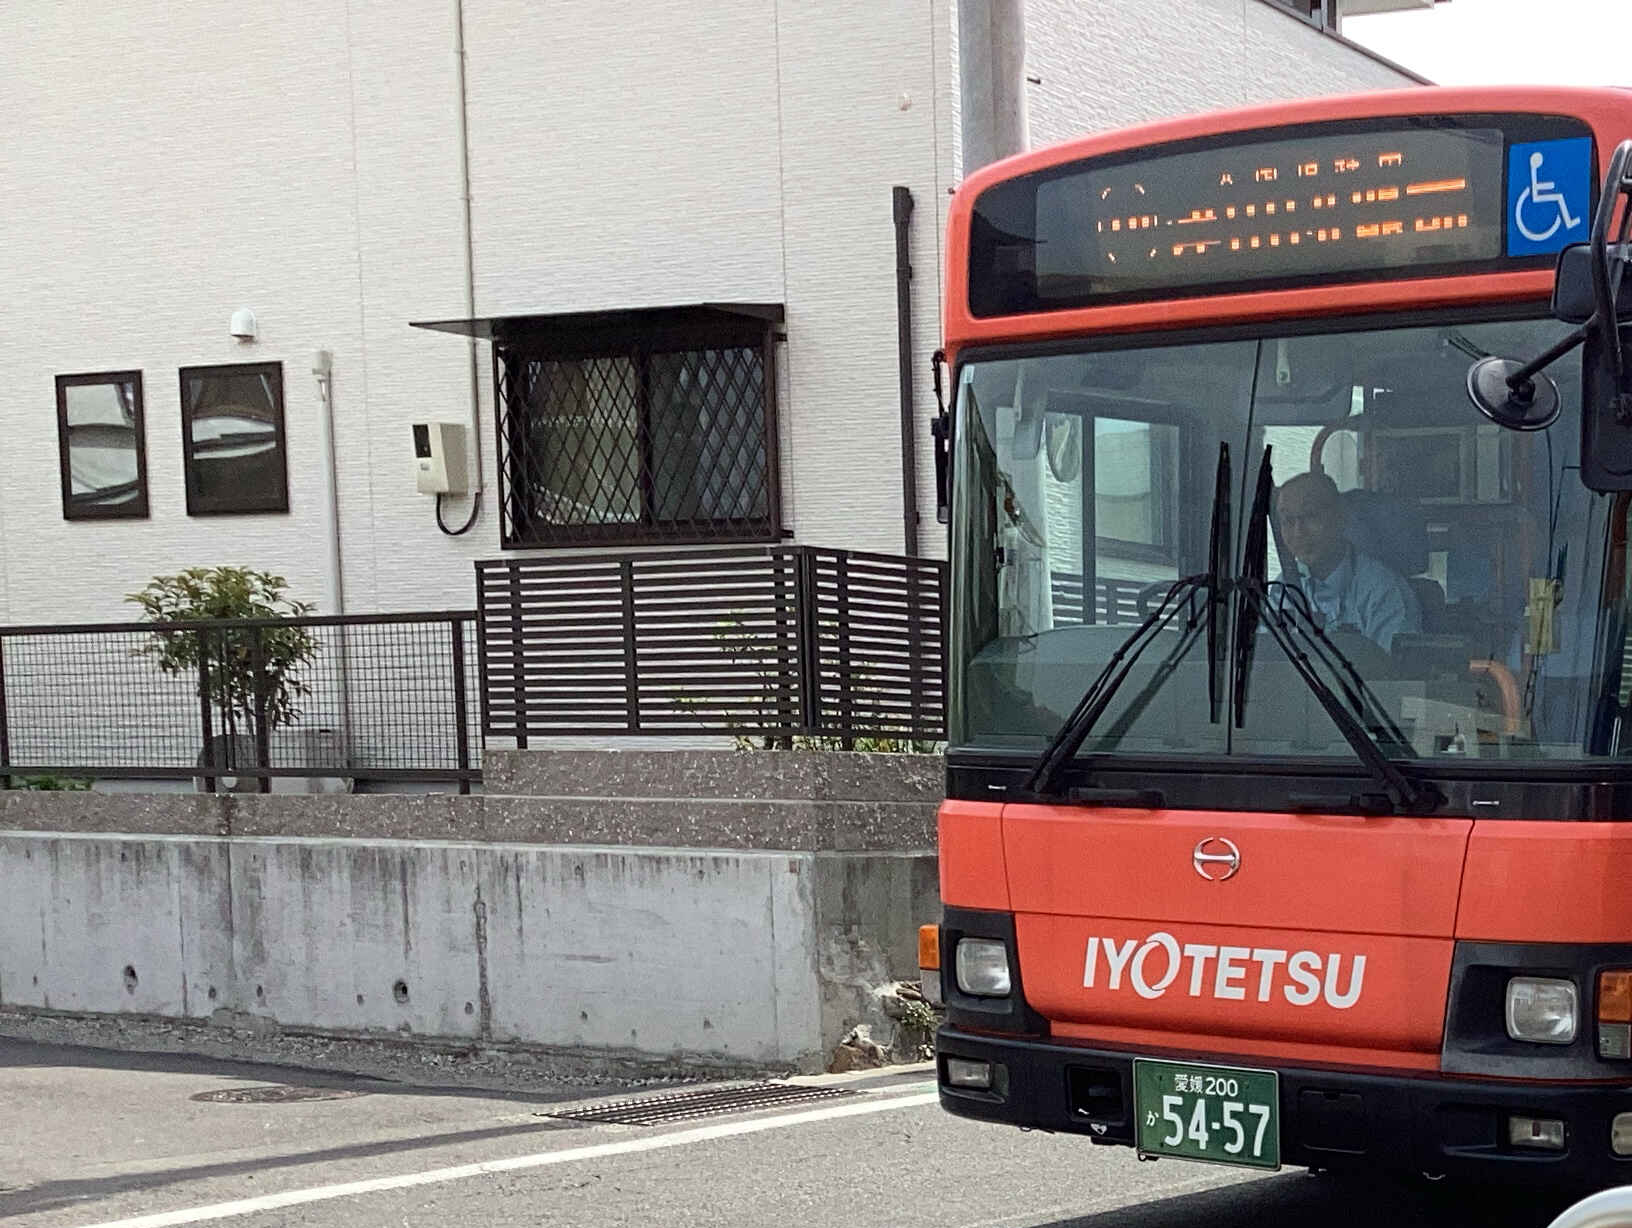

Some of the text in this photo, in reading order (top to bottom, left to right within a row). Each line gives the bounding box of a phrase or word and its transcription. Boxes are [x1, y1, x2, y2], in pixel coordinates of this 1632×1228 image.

[1083, 931, 1367, 1010] IYOTETSU
[1174, 1073, 1239, 1097] 愛媛 200
[1145, 1094, 1270, 1157] か 54-57
